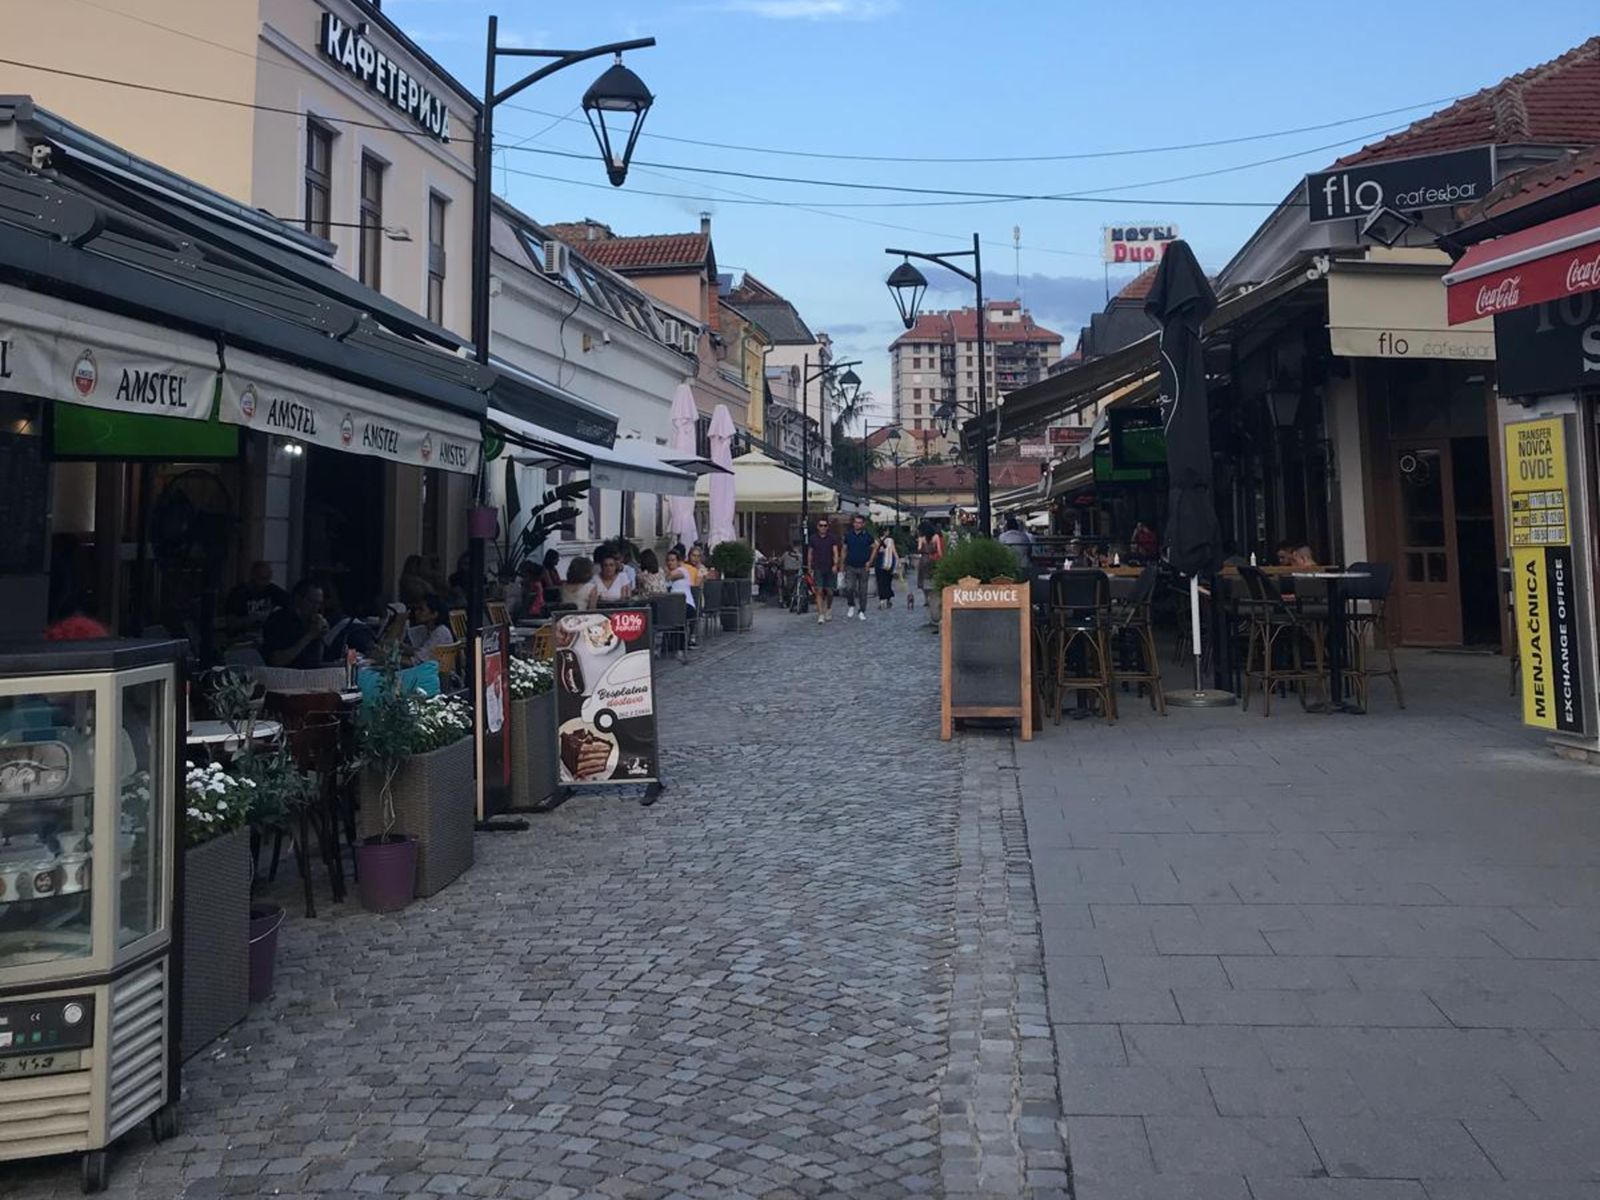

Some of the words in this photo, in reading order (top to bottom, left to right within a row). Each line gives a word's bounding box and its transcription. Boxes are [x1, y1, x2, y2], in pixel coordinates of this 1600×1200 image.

[327, 13, 450, 143] КАФЕТЕРИЈА
[1323, 174, 1383, 216] flo
[1395, 183, 1476, 206] cafe&bar
[1111, 226, 1176, 241] HOTEL
[1379, 332, 1409, 355] flo
[116, 368, 187, 408] AMSTEL
[267, 398, 317, 436] AMSTEL
[363, 423, 398, 454] AMSTEL
[439, 441, 467, 467] AMSTEL
[1518, 428, 1552, 441] TRANSFER
[1518, 440, 1552, 457] NOVCA
[1520, 458, 1554, 480] OVDE
[953, 586, 1018, 605] KRUŠOVICE
[1555, 558, 1567, 619] OFFICE
[614, 614, 642, 626] 10%
[1526, 560, 1546, 718] MENJAČNICA
[1559, 622, 1574, 723] EXCHANGE
